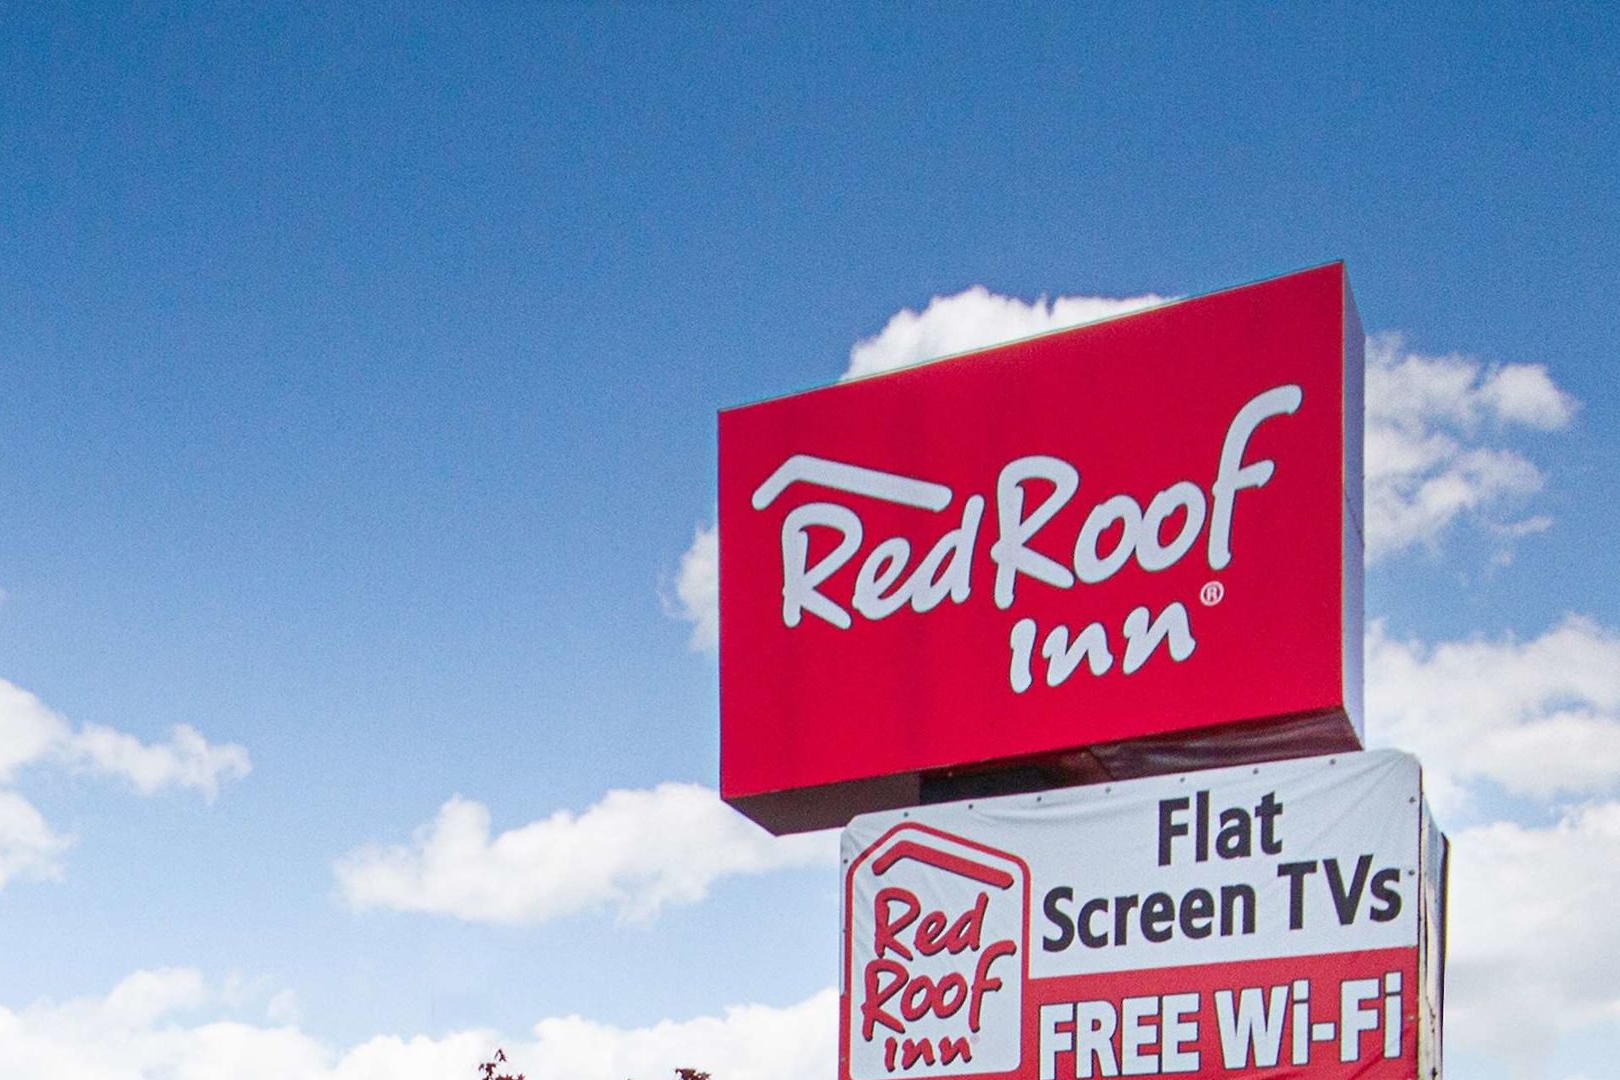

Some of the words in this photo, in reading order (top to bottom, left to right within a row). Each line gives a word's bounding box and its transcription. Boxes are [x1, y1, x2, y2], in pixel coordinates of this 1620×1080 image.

[1159, 791, 1282, 866] Flat
[874, 887, 989, 960] Red
[1043, 880, 1256, 952] Screen
[1277, 854, 1401, 931] TVs
[861, 940, 1017, 1041] Roof
[1214, 972, 1402, 1070] Wi-Fi
